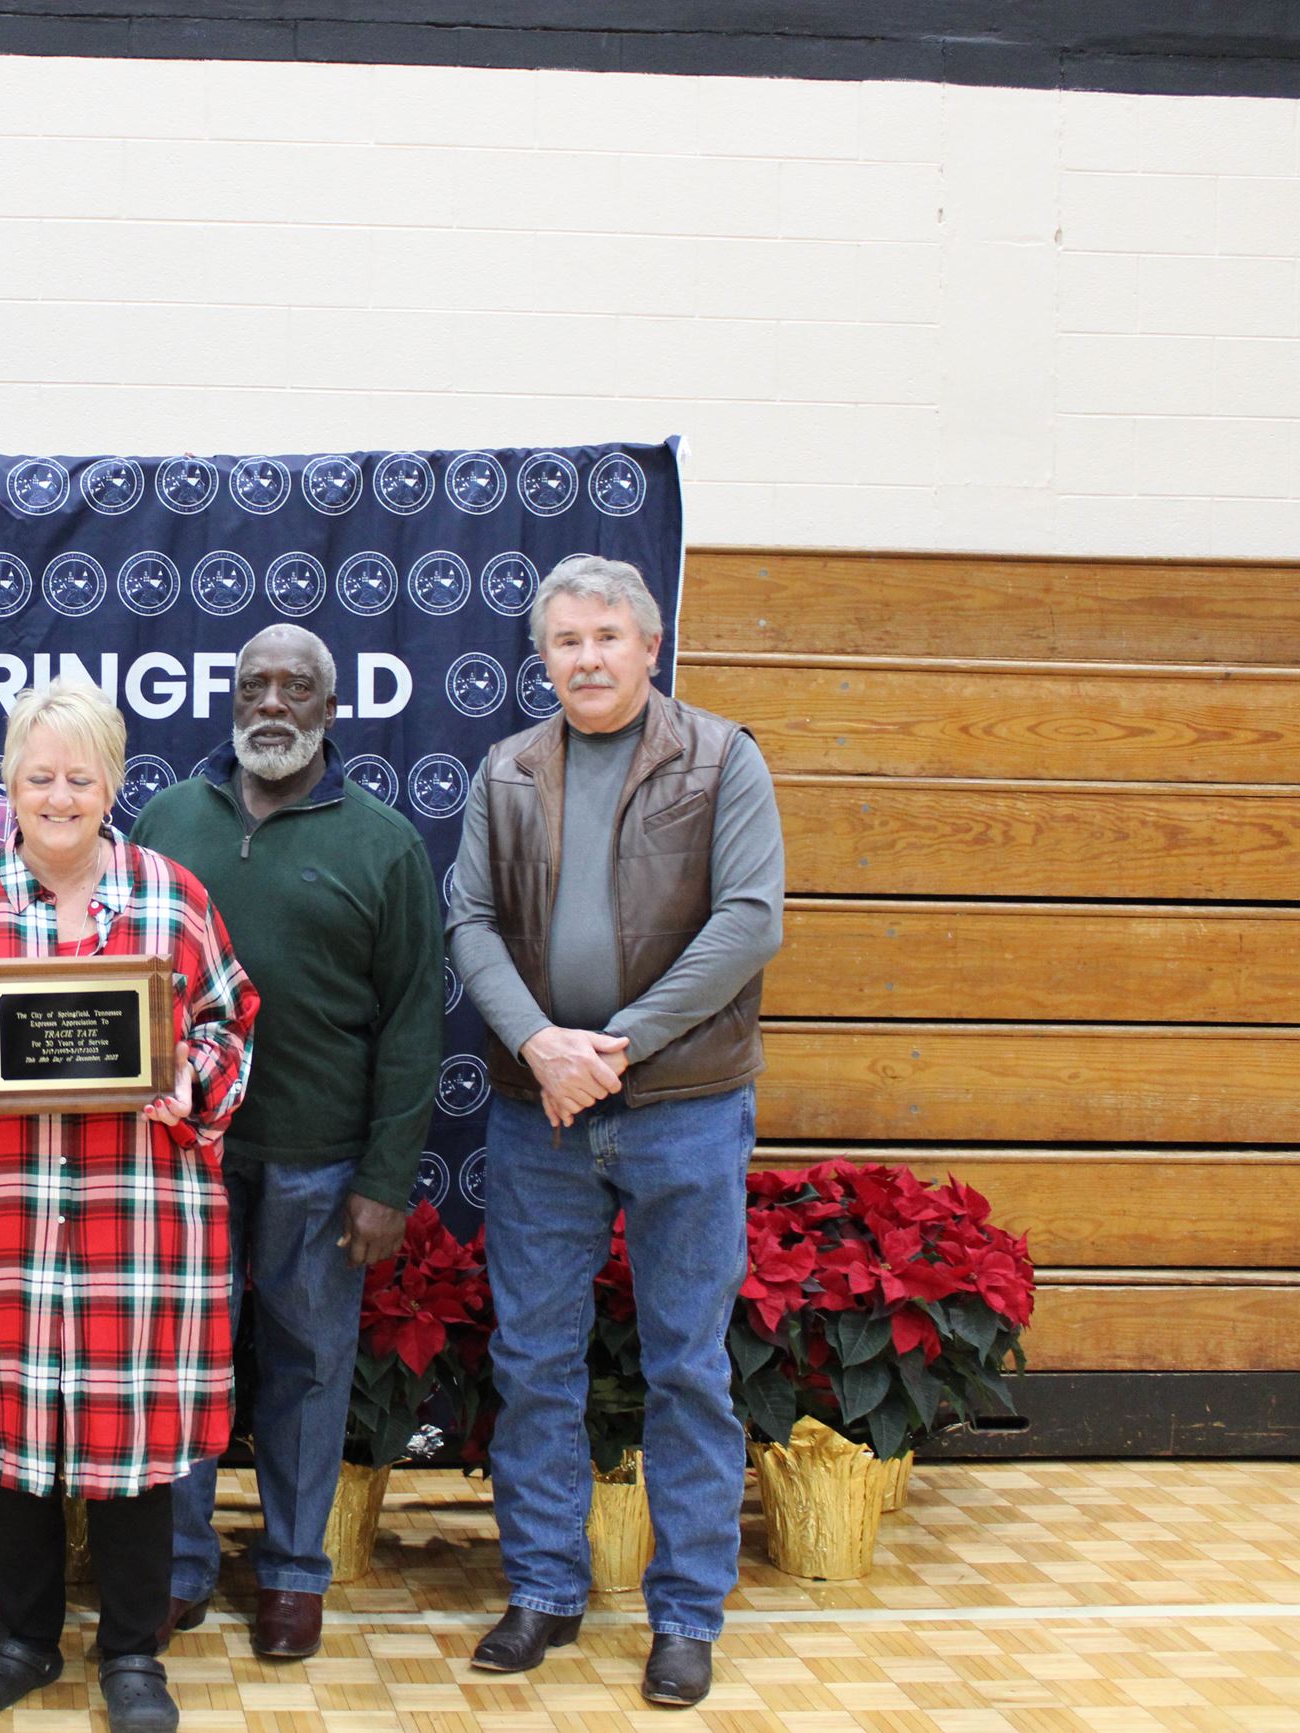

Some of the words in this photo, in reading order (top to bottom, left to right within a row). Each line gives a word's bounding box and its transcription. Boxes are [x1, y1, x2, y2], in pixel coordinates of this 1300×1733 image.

[30, 1011, 43, 1020] City
[94, 1009, 122, 1017] Tennessee
[61, 1019, 97, 1027] Appreciation
[44, 1030, 74, 1039] TRACIE
[77, 1029, 98, 1038] TATE
[31, 1040, 42, 1048] For
